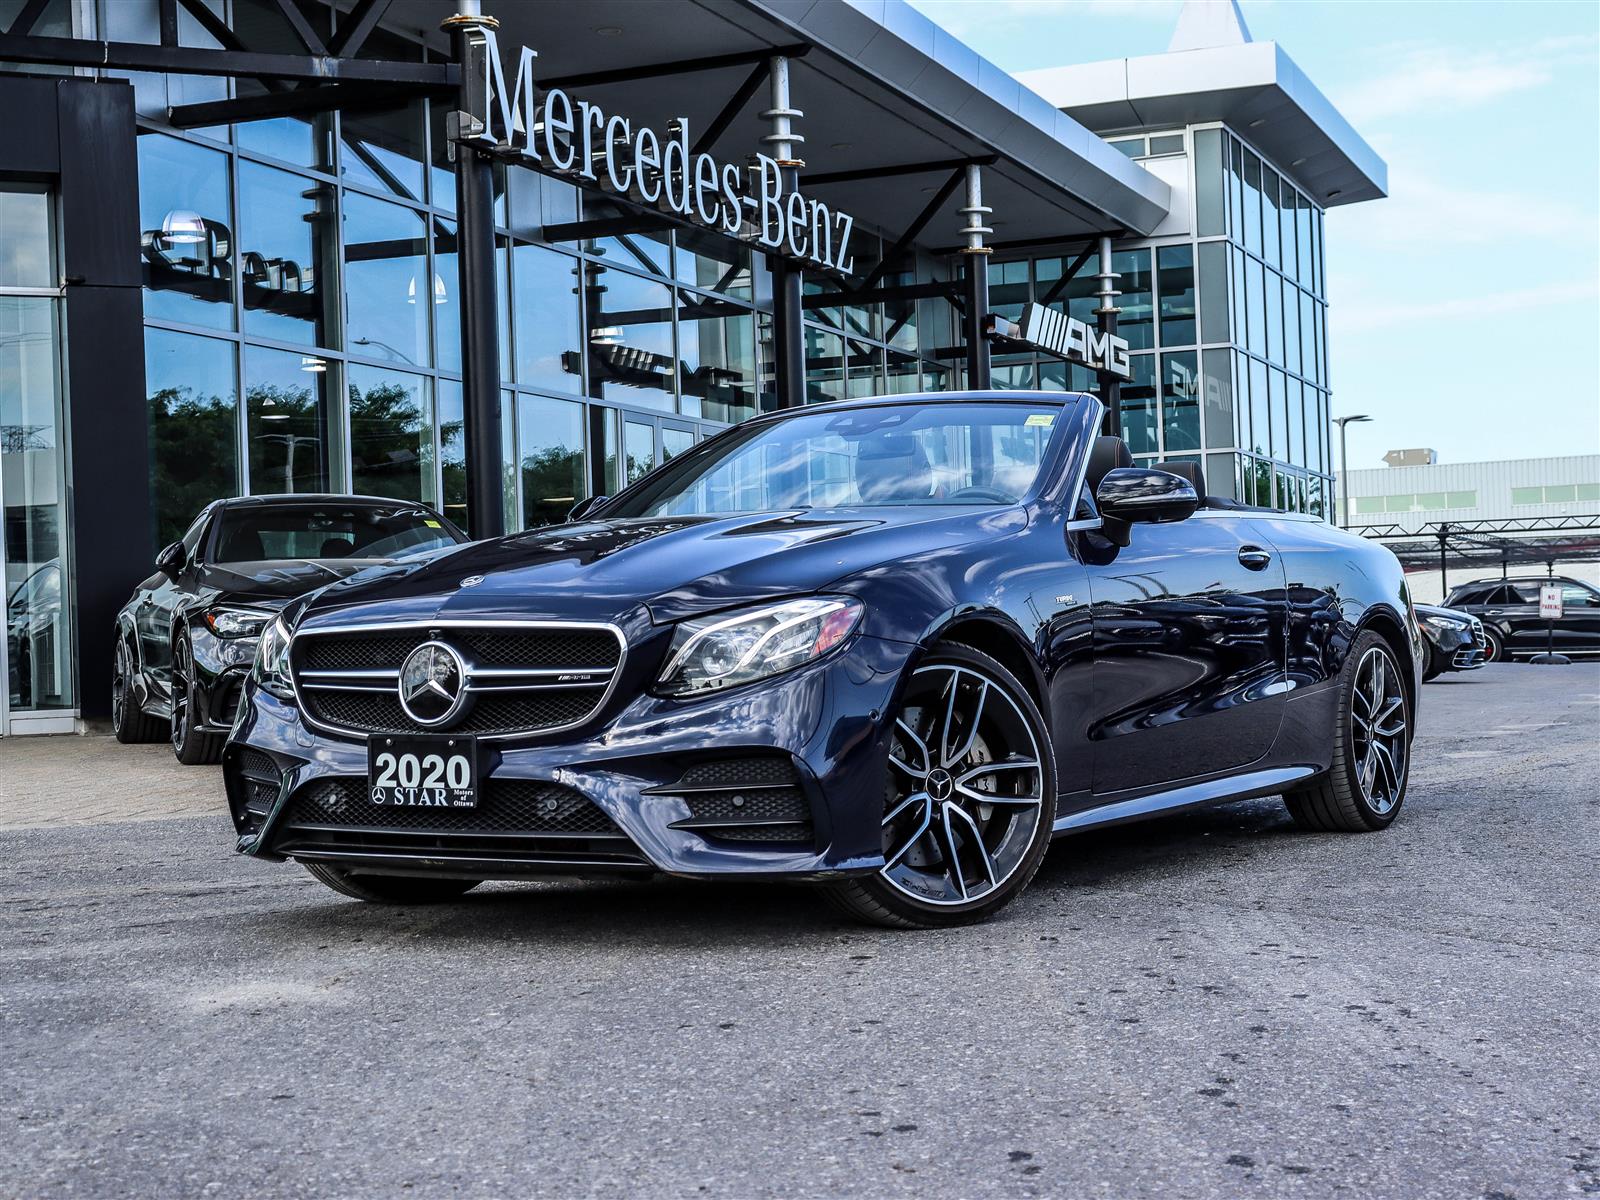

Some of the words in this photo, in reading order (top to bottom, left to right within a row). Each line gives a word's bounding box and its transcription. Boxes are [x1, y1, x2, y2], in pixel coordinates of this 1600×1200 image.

[479, 24, 854, 275] Mercedes-Benz
[376, 752, 470, 789] 2020
[394, 787, 448, 806] STAR
